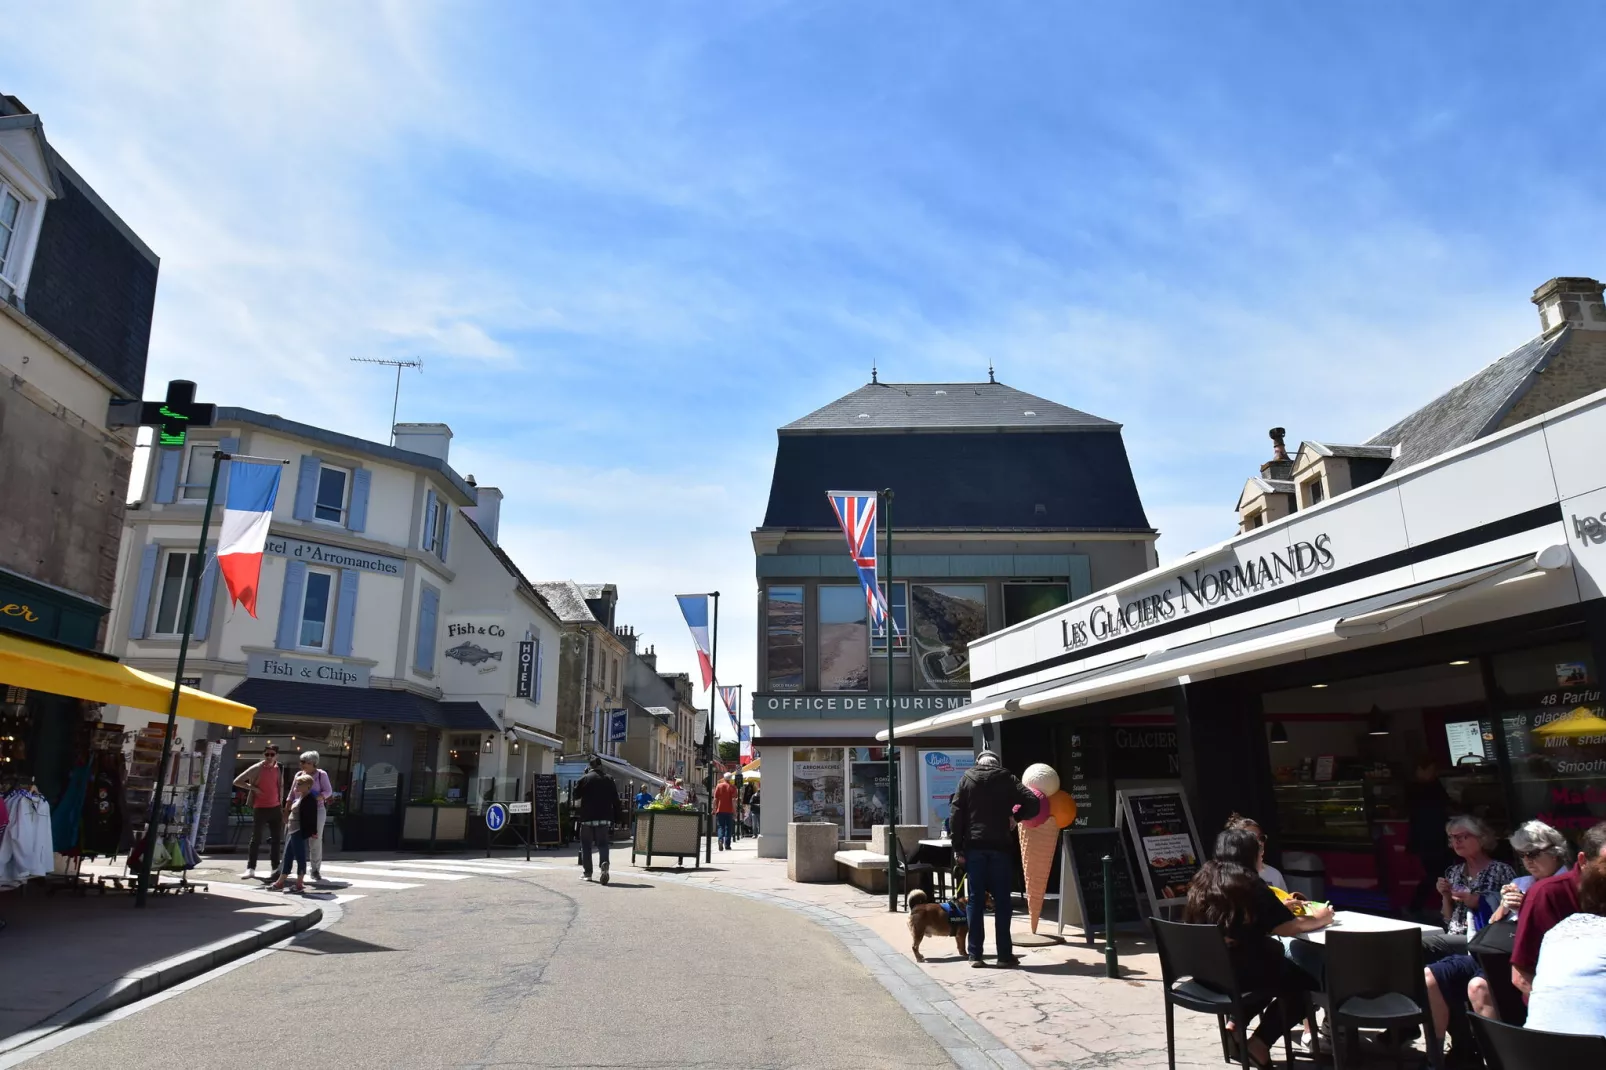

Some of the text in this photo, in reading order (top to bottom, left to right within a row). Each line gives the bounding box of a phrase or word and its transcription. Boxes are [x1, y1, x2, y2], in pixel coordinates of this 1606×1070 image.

[294, 545, 398, 574] d'Arromanches
[1176, 533, 1333, 611] NORMANDS
[448, 622, 505, 637] Fish & Co
[262, 660, 357, 684] Fish & Chips
[520, 644, 531, 691] HOTEL
[768, 698, 837, 710] OFFICE
[844, 698, 867, 710] DE
[1541, 694, 1557, 706] 48
